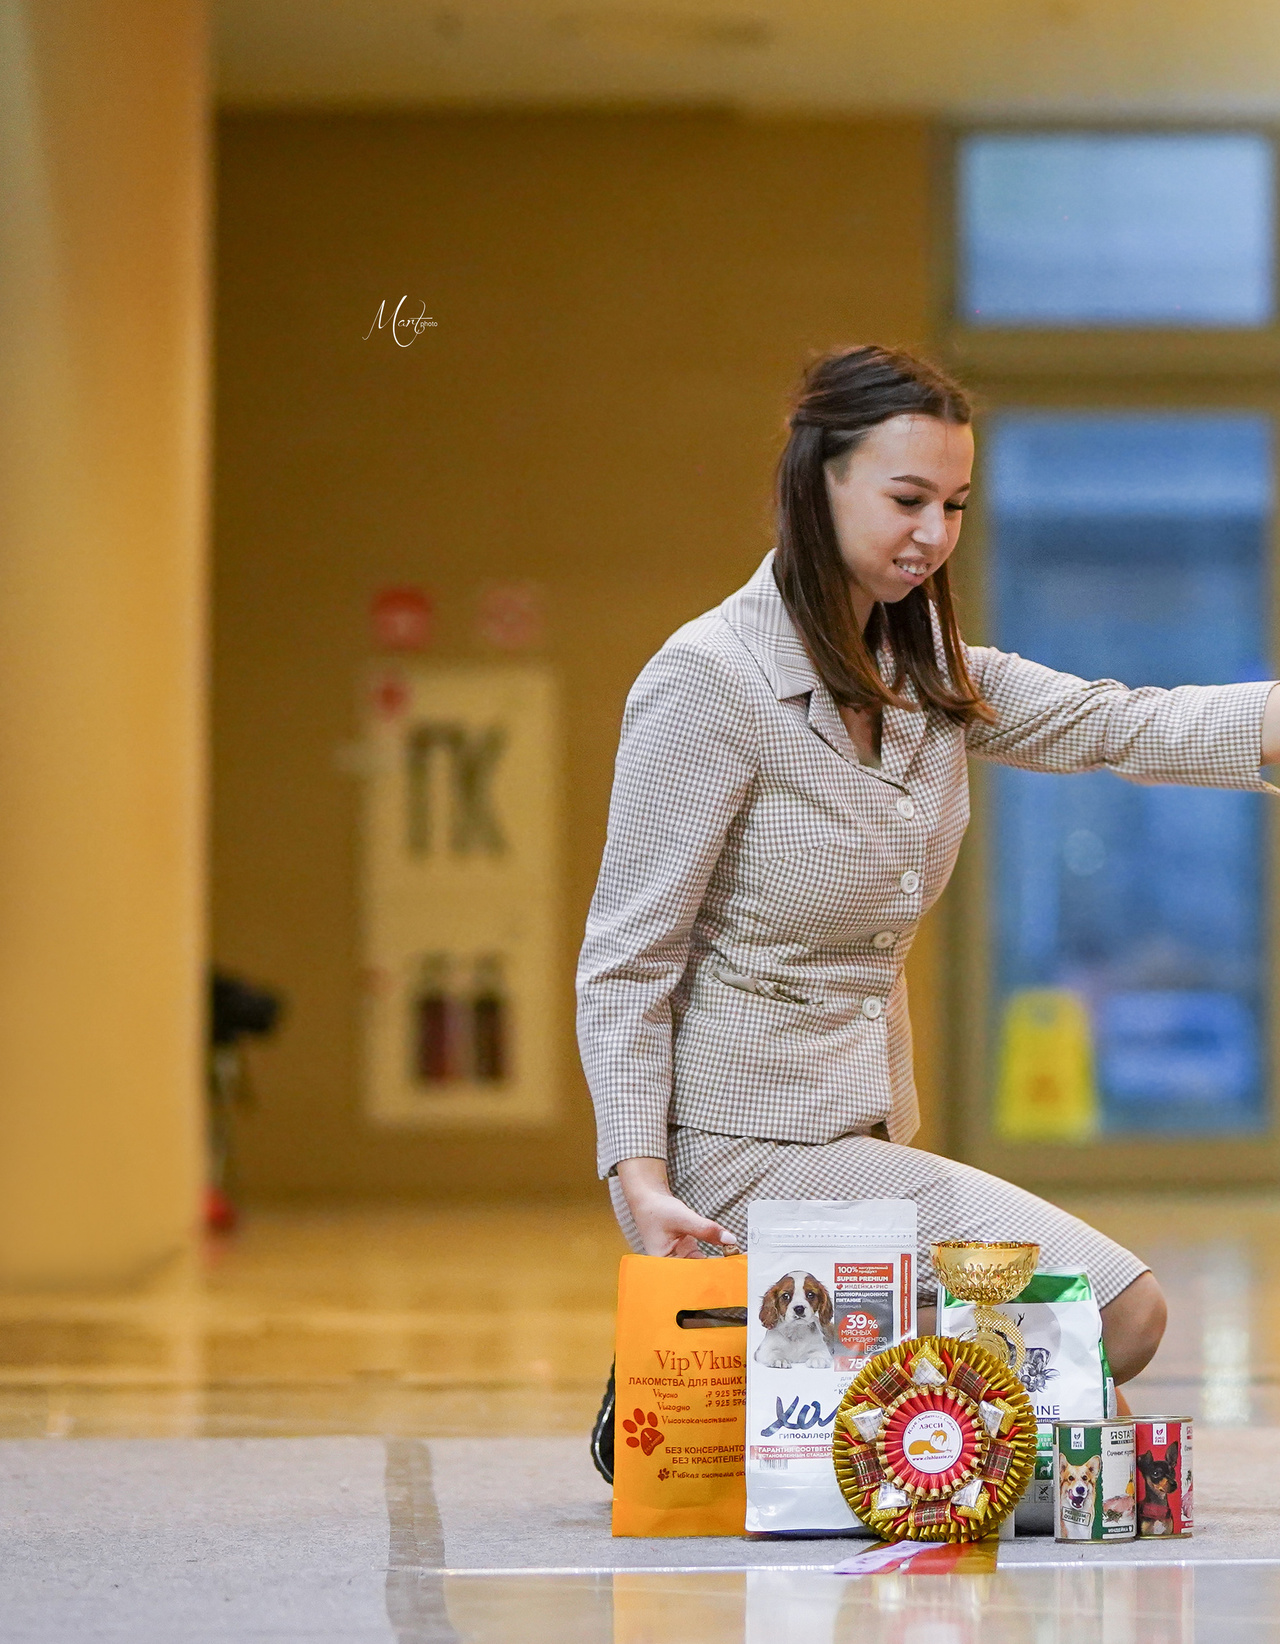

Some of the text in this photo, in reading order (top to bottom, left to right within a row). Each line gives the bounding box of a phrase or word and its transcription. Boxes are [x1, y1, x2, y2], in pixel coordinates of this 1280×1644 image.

[838, 1266, 858, 1274] 100%
[628, 1376, 743, 1388] ЛАКОМСТВА ДЛЯ ВАШИХ
[715, 1390, 730, 1398] 925
[672, 1453, 745, 1464] БЕЗ КРАСИТЕЛЕЙ
